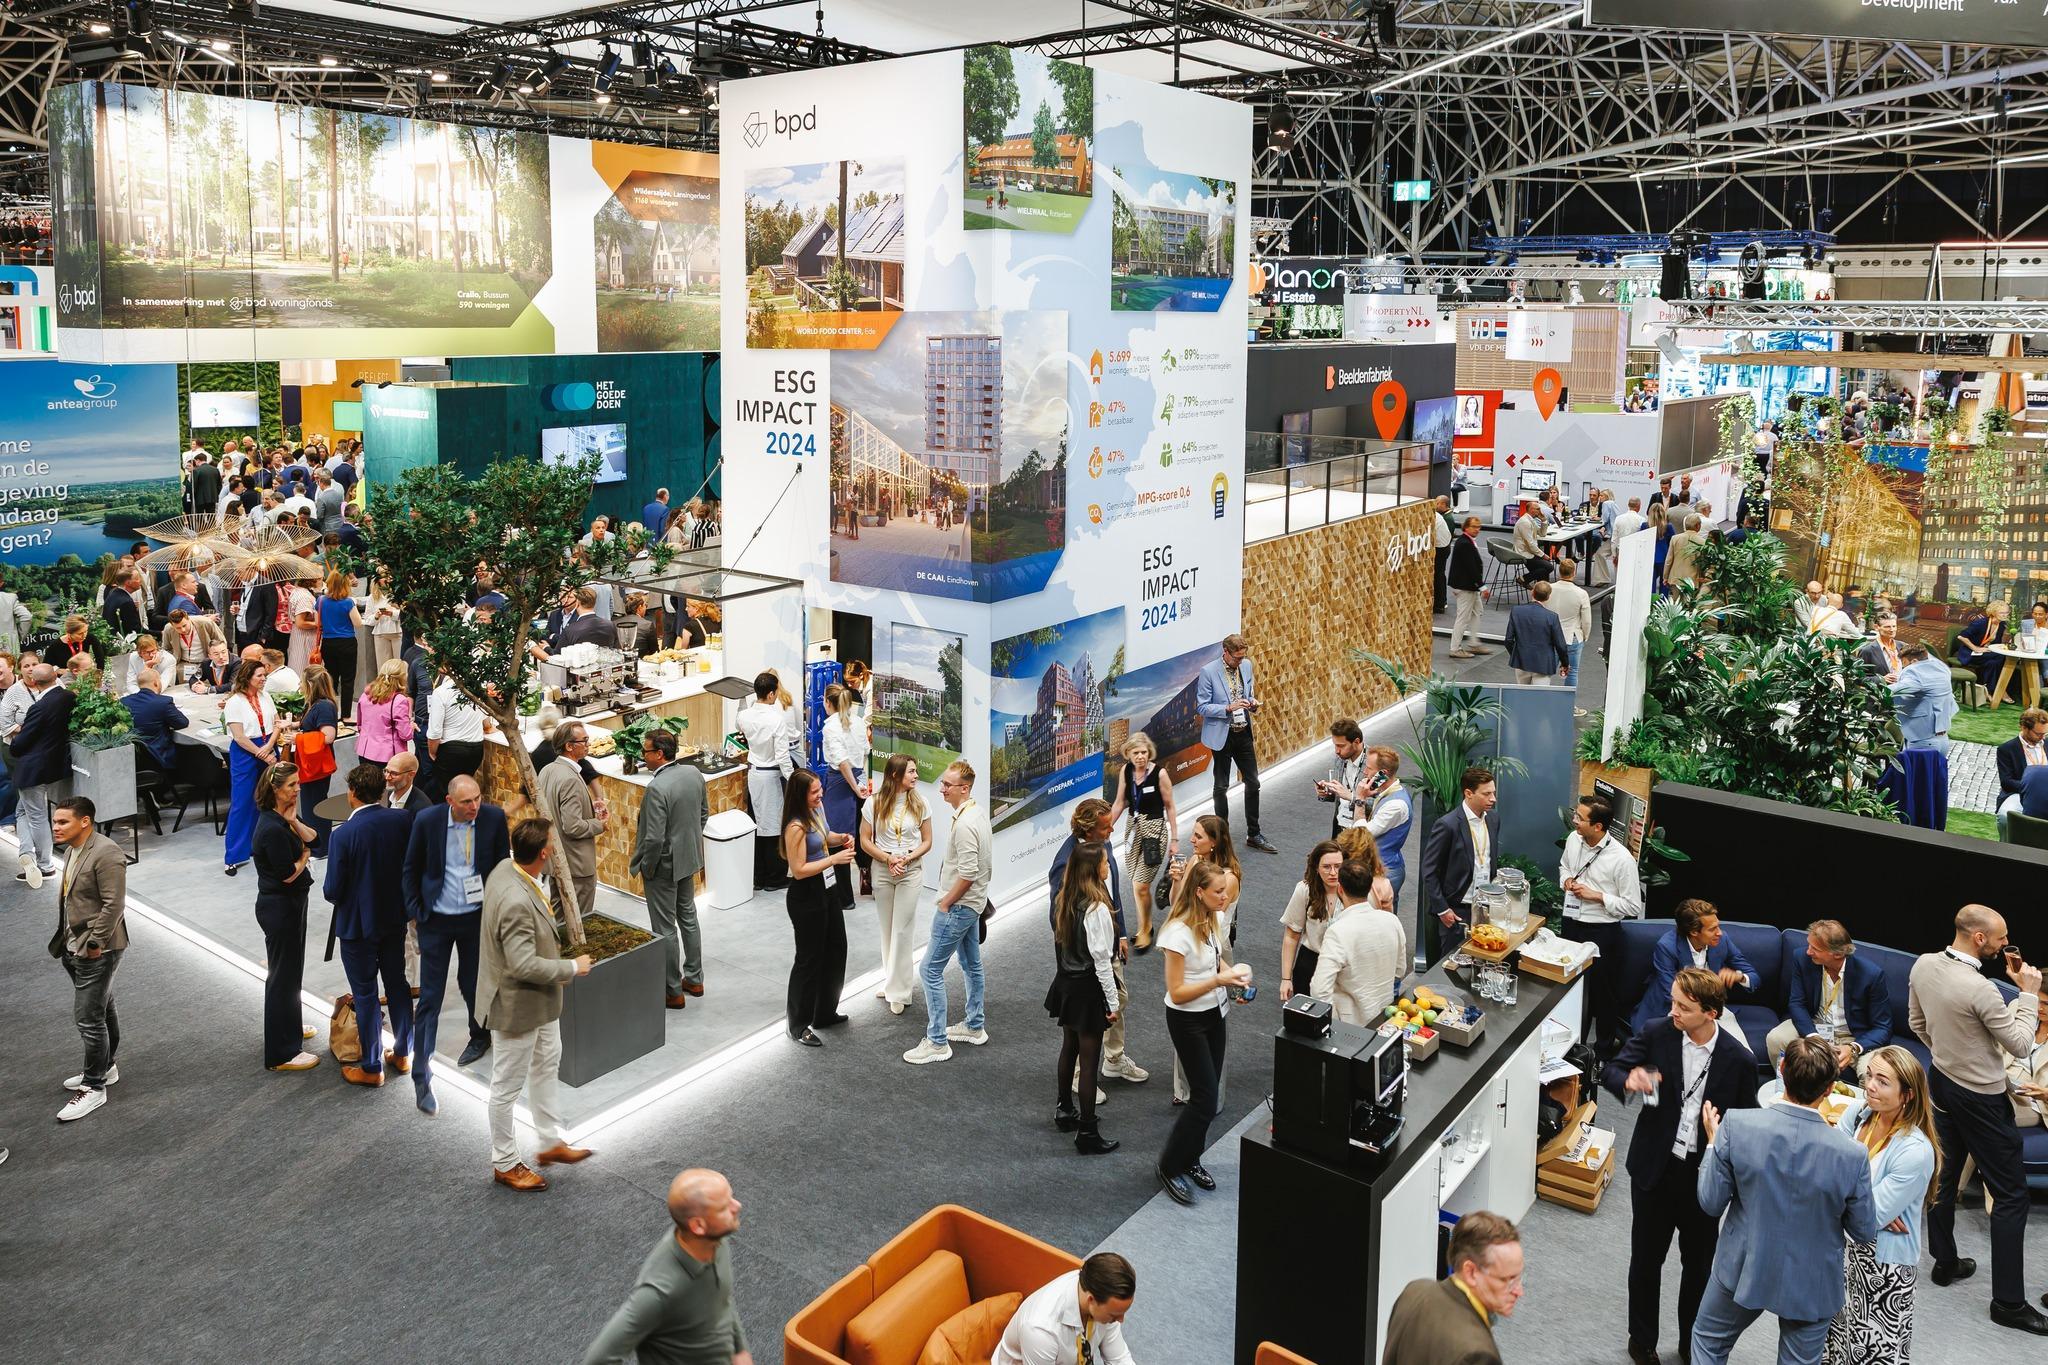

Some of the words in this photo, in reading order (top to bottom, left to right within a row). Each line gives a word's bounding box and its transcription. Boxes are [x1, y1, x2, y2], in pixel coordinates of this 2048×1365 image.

[775, 104, 816, 140] bpd
[1260, 262, 1349, 289] Planon
[75, 284, 96, 311] bpd
[122, 297, 132, 306] In
[206, 297, 225, 307] met
[269, 298, 333, 309] woningfonds
[483, 291, 509, 299] Bussum
[1282, 291, 1316, 303] Estate
[459, 301, 473, 309] 590
[475, 301, 510, 311] woningen
[796, 327, 819, 336] WORLD
[819, 327, 837, 336] FOOD
[838, 327, 864, 336] CENTER,
[1468, 318, 1497, 340] VDL
[1184, 348, 1200, 360] 89%
[1469, 343, 1483, 352] VDL
[1485, 343, 1494, 352] DE
[1495, 343, 1506, 352] ME
[1109, 350, 1132, 363] 5.699
[774, 369, 816, 394] ESG
[1338, 365, 1393, 386] Beeldenfabriek
[596, 380, 614, 391] HET
[596, 390, 626, 400] GOEDE
[1183, 395, 1199, 408] 79%
[596, 399, 621, 409] DOEN
[736, 399, 817, 425] IMPACT
[1108, 400, 1126, 413] 47%
[766, 431, 817, 457] 2024
[1182, 441, 1198, 454] 64%
[1107, 449, 1125, 464] 47%
[0, 466, 17, 478] n
[23, 459, 50, 476] de
[1137, 490, 1178, 506] MPG-score
[1179, 486, 1191, 498] 0,6
[1, 528, 52, 553] gen?
[1407, 525, 1431, 562] bpd
[1143, 544, 1173, 572] ESG
[916, 571, 926, 580] DE
[946, 575, 979, 587] Eindhoven
[1142, 567, 1199, 601] IMPACT
[1141, 601, 1178, 631] 2024
[872, 749, 896, 760] MUSVE
[1047, 778, 1075, 795] HYDEPARK,
